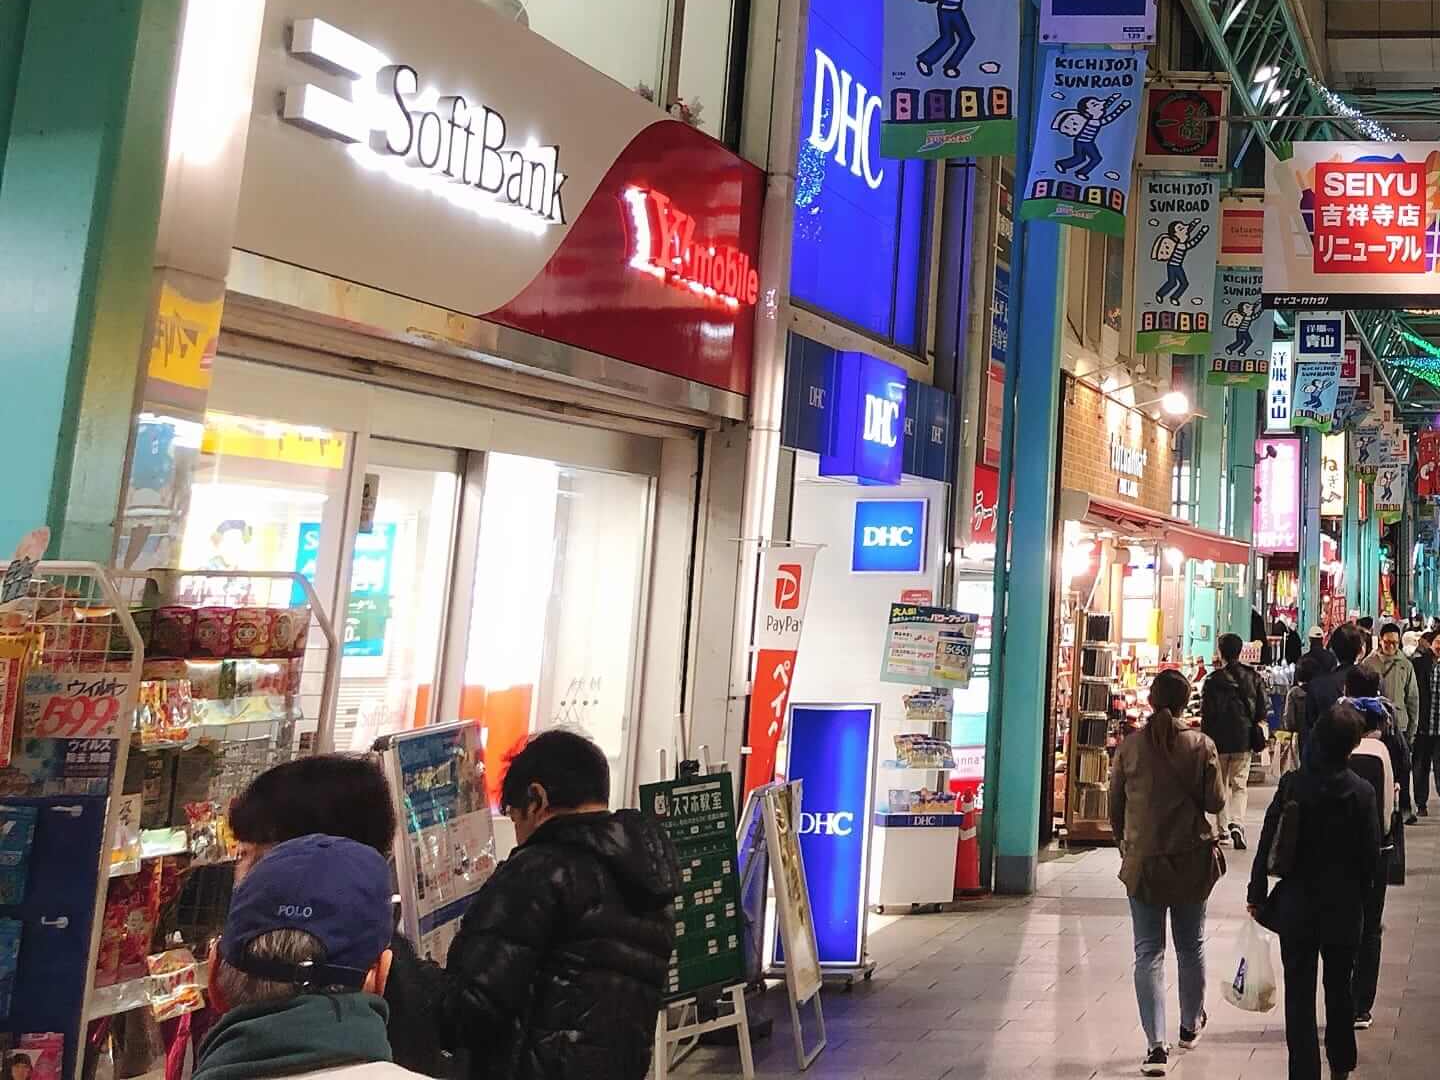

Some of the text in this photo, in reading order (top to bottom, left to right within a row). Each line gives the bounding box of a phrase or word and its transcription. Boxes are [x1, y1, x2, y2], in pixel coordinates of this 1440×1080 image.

[1055, 57, 1138, 72] KICHIJOJI
[1054, 73, 1134, 88] SUNROAD
[809, 47, 884, 190] DHC
[376, 64, 568, 226] SoftBank
[1149, 182, 1213, 195] KICHIJOJI
[1323, 171, 1418, 197] SEIYU
[1150, 199, 1210, 214] SUNROAD
[1320, 203, 1420, 228] 吉祥寺店
[1319, 234, 1422, 264] リニューアル
[1305, 334, 1335, 348] 青山
[863, 394, 899, 448] DHC
[863, 526, 914, 547] DHC
[766, 614, 801, 635] PayPa
[36, 695, 120, 737] 599
[672, 791, 723, 817] スマホ教室
[800, 811, 854, 836] DHC
[913, 815, 936, 826] DHC
[278, 904, 313, 918] POLO
